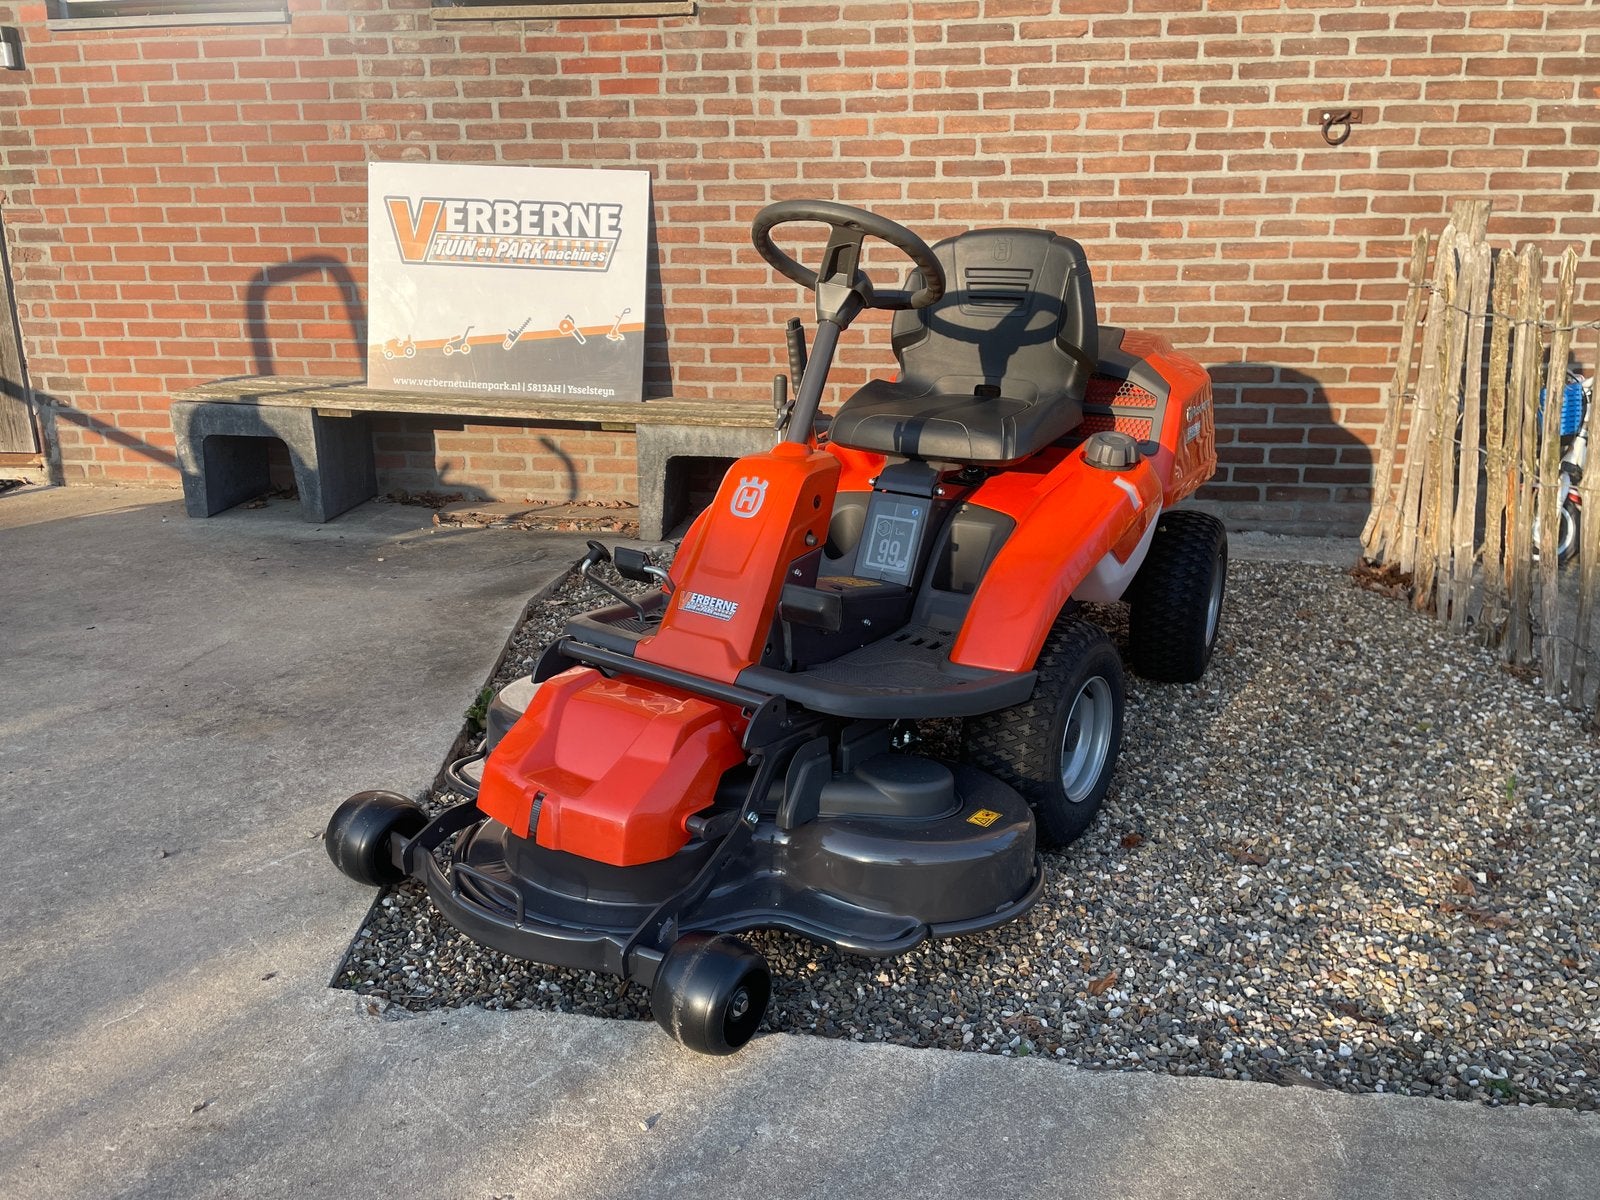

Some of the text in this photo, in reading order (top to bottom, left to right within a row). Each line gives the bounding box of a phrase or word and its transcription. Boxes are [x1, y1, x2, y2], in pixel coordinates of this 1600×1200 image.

[386, 198, 622, 262] VERBERNE
[434, 238, 606, 263] TUIN en PARK machines
[393, 376, 521, 392] www.verbernetuinenpark.nl
[527, 384, 562, 394] 5813AH
[567, 385, 615, 398] Ysselsteyn
[877, 539, 901, 565] 99
[678, 590, 739, 613] VERBERNE
